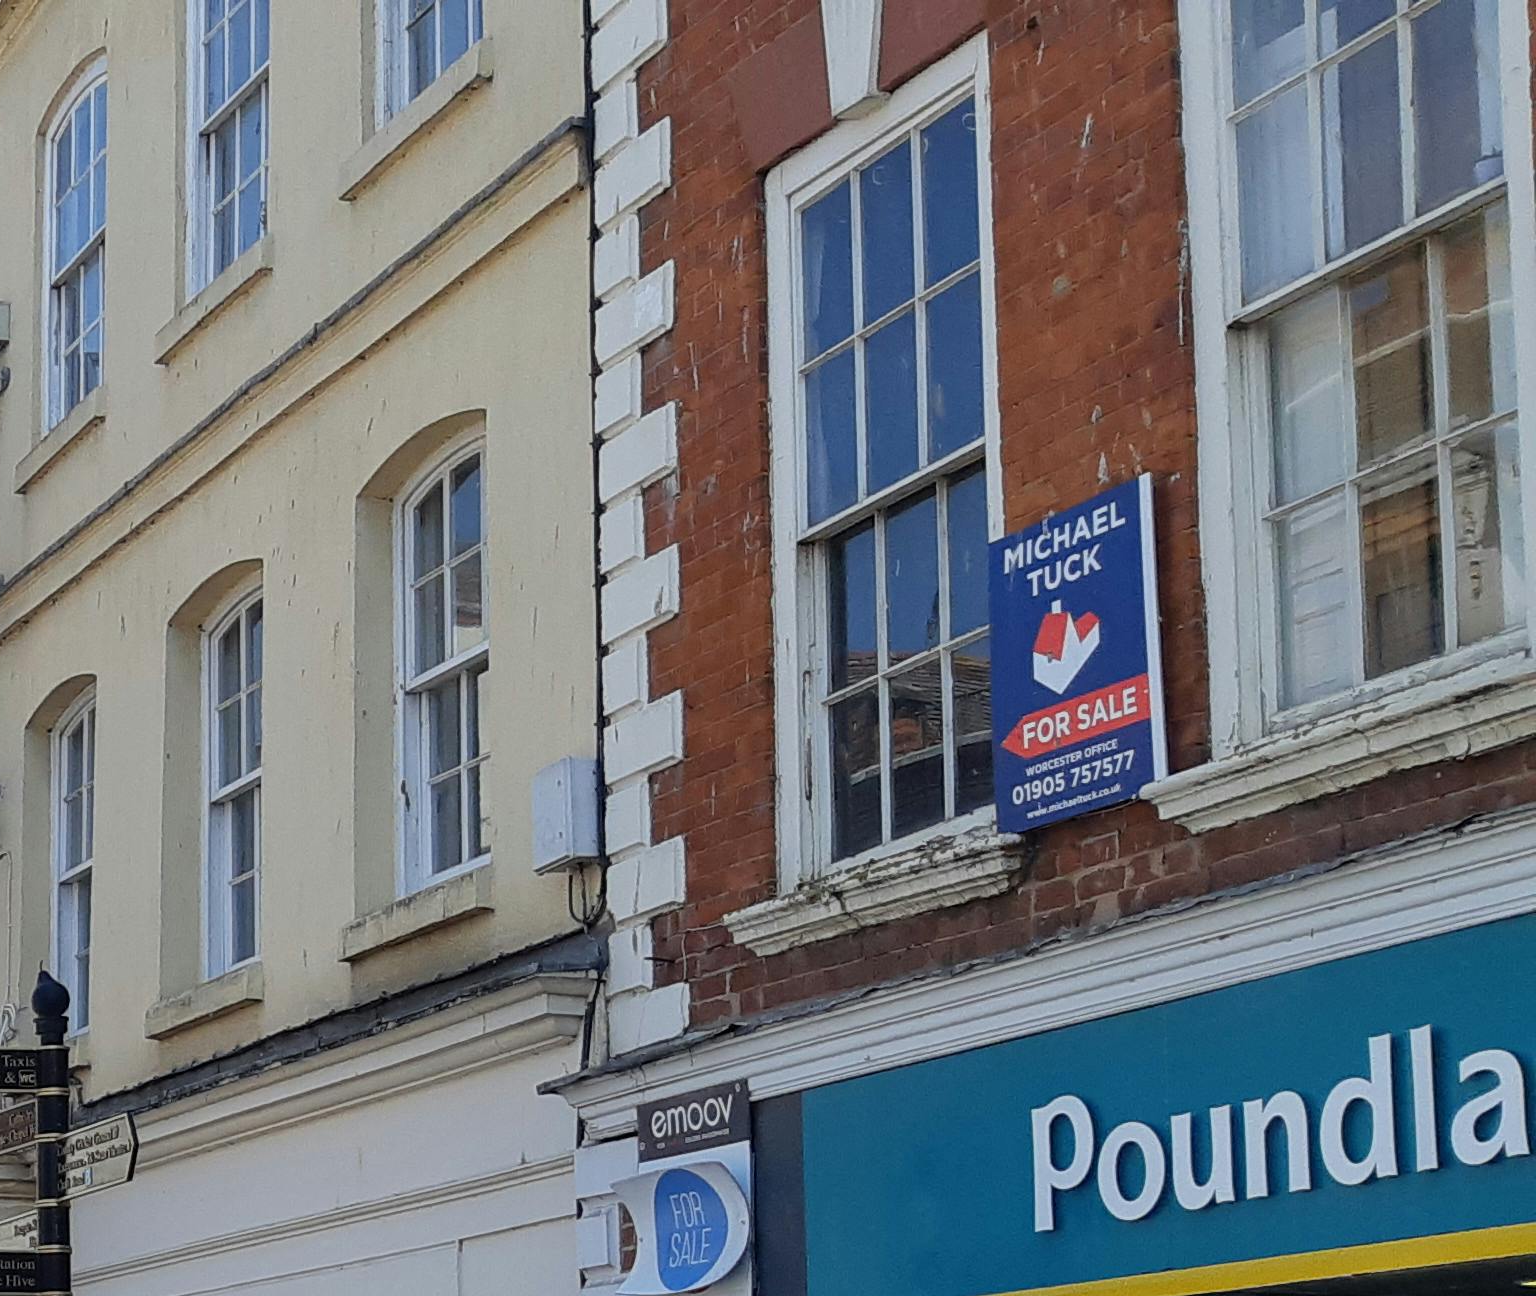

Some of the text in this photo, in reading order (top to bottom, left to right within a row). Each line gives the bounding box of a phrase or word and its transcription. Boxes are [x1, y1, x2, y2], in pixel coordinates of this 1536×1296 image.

[1004, 502, 1126, 575] MICHAEL
[1027, 544, 1102, 597] TUCK
[1023, 686, 1137, 749] FOR SALE
[1012, 749, 1135, 806] 01905 757577
[1026, 738, 1118, 776] WORCESTER OFFICE
[2, 1054, 36, 1067] Taxis
[5, 1072, 16, 1084] &
[651, 1095, 732, 1139] emoov
[669, 1191, 705, 1228] FOR
[669, 1227, 712, 1268] SALE
[6, 1274, 36, 1287] Hive
